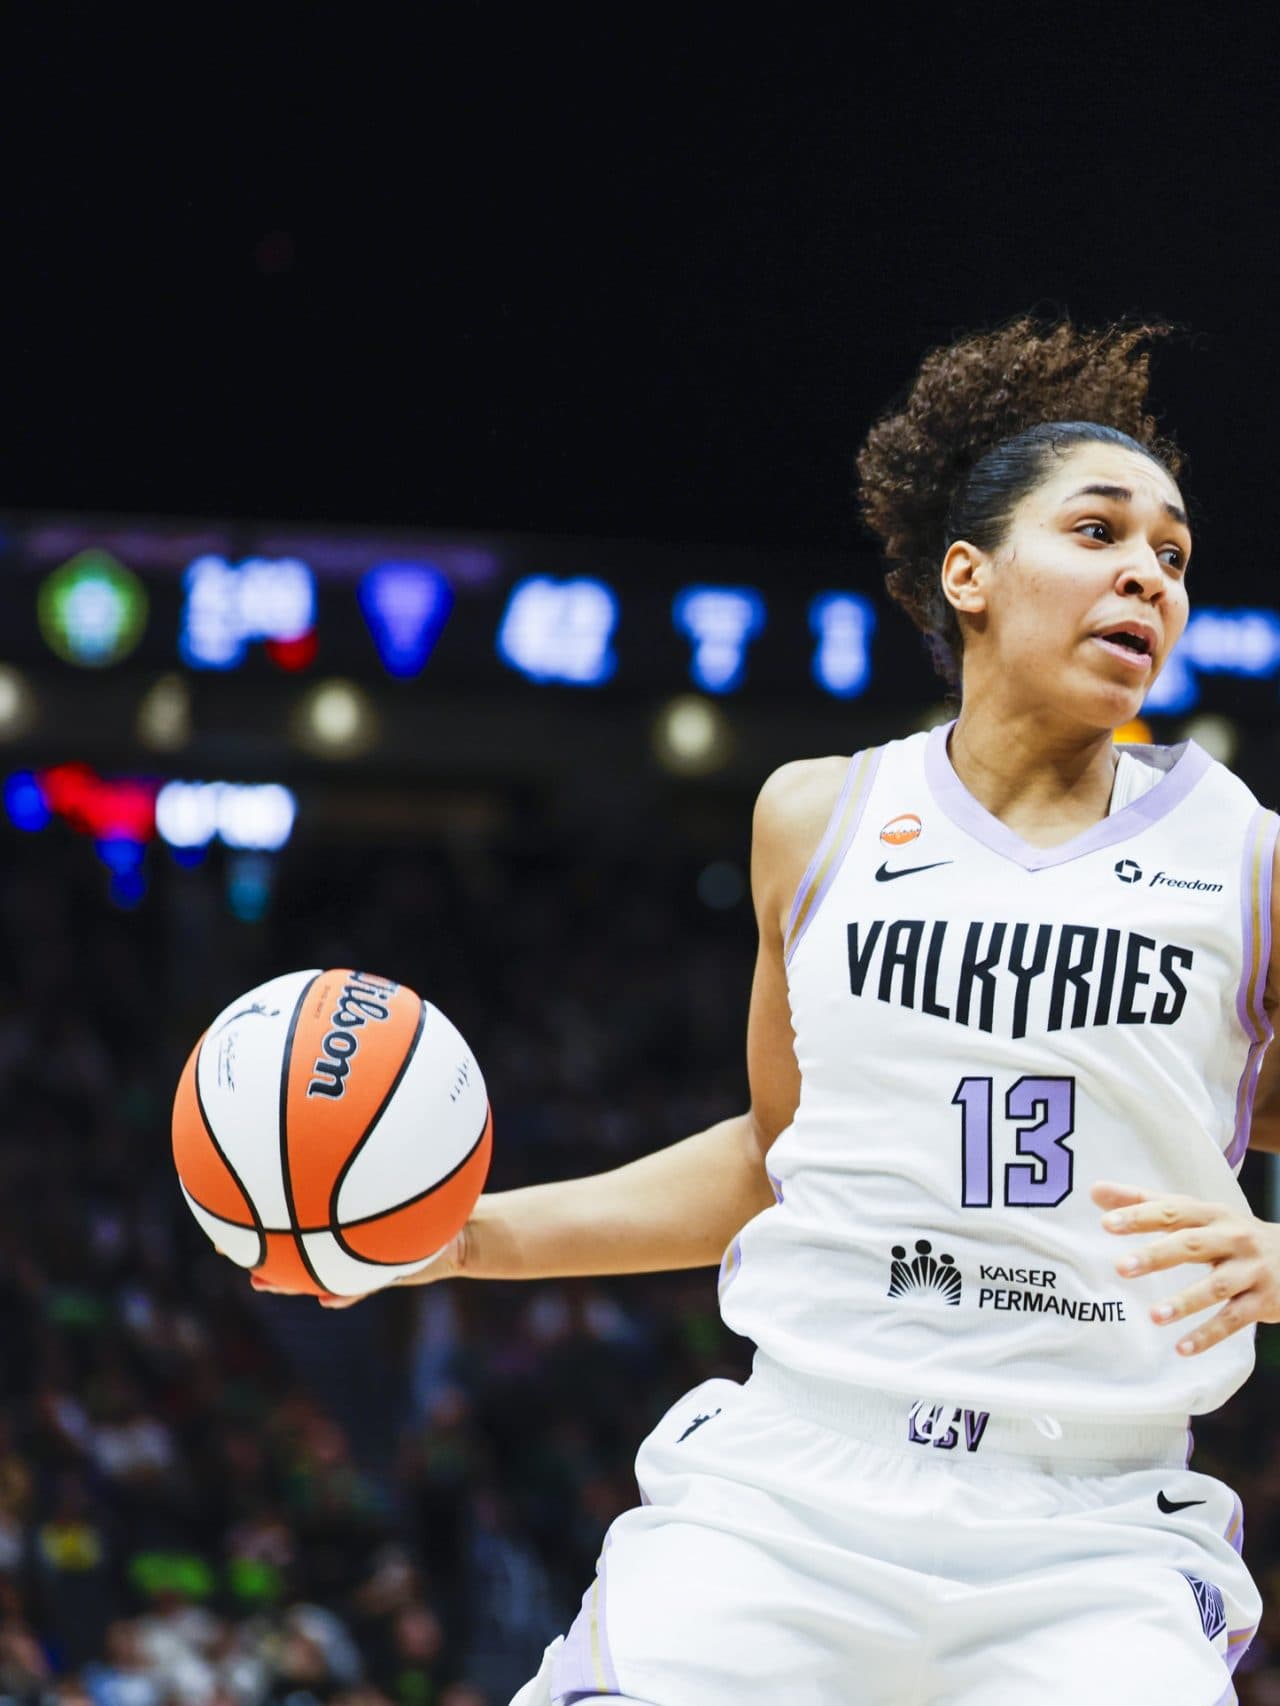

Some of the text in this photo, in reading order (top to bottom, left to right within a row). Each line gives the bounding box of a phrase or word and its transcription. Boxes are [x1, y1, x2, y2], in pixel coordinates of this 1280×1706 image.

[1149, 871, 1224, 892] freedom
[847, 919, 1194, 1040] VALKYRIES
[951, 1075, 1076, 1208] 13
[979, 1264, 1057, 1289] KAISER
[978, 1287, 1127, 1323] PERMANENTE
